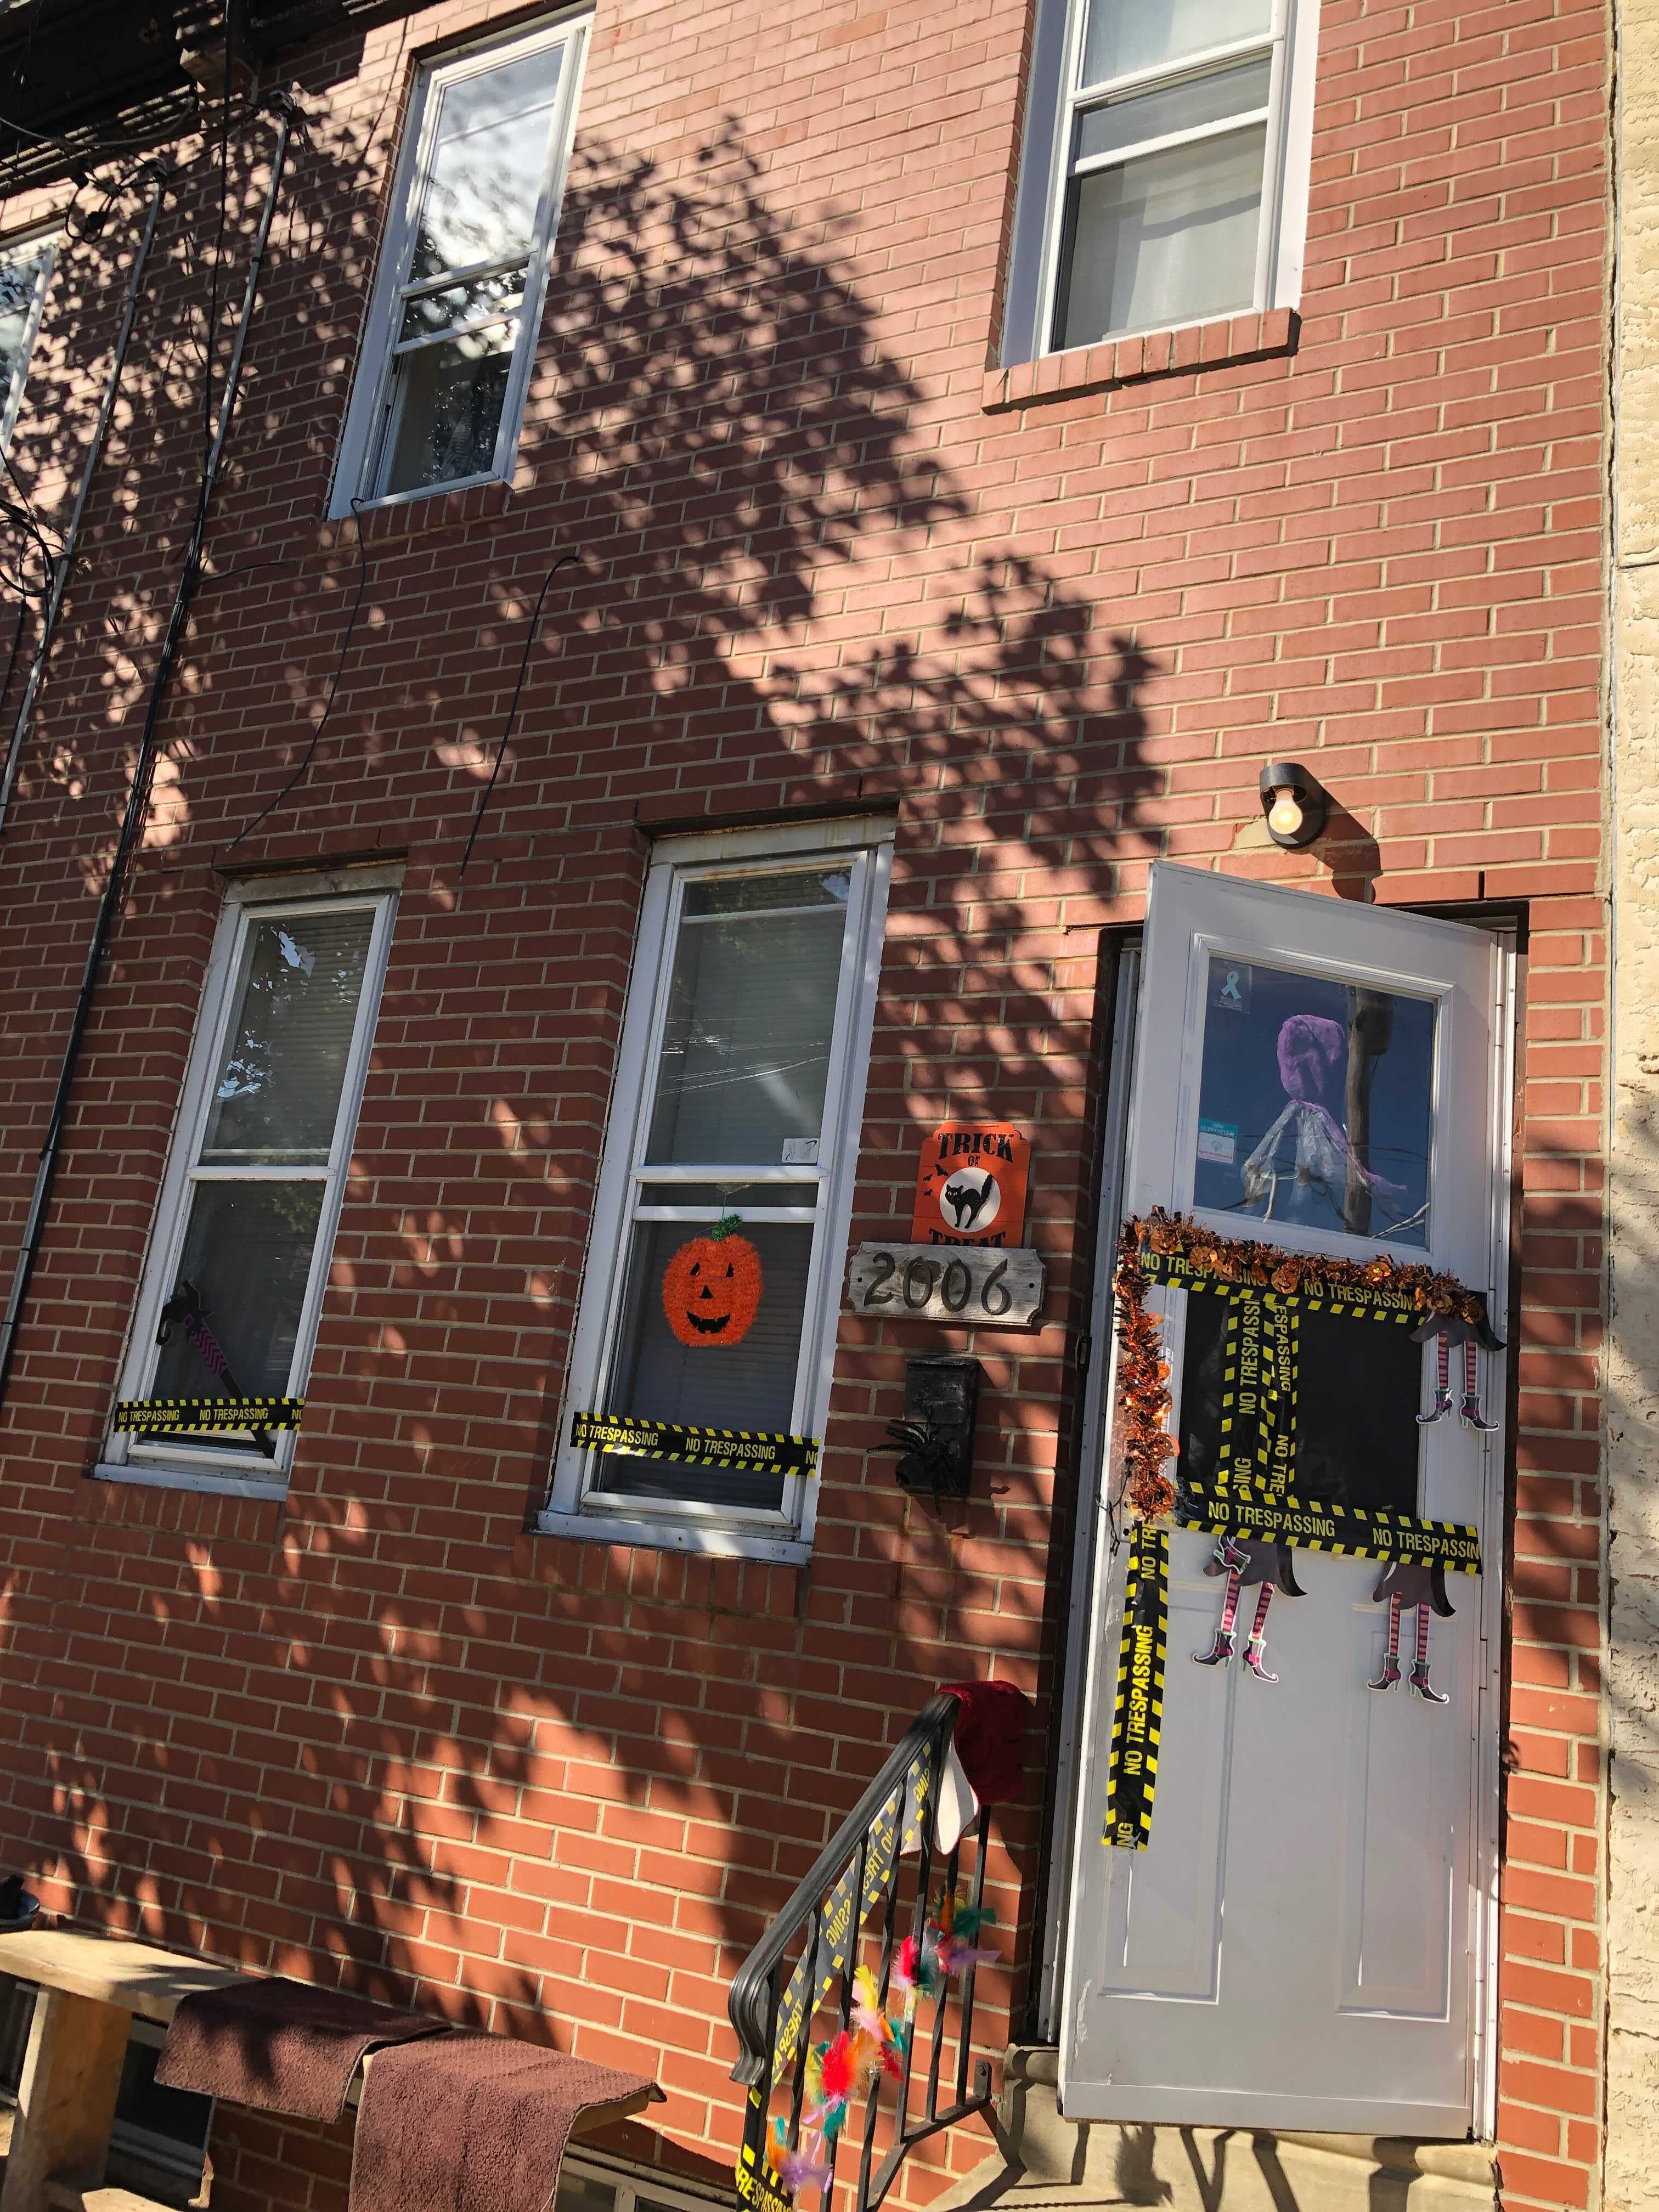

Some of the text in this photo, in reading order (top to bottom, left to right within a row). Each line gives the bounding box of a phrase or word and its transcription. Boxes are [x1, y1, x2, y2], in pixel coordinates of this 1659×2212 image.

[938, 1133, 1014, 1163] TRICK
[864, 1252, 1012, 1316] 2006
[1141, 1252, 1160, 1271] NO
[1304, 1279, 1324, 1297] NO
[1328, 1283, 1413, 1311] TRESPASSIN
[118, 1412, 127, 1423] NO
[129, 1409, 180, 1422] TRESPASSING
[199, 1409, 211, 1421] NO
[213, 1408, 268, 1420] TRESPASSING
[1238, 1392, 1257, 1415] NO
[576, 1424, 586, 1437] NO
[589, 1425, 658, 1446] TRESPASSING
[685, 1437, 701, 1452] NO
[704, 1440, 776, 1460] TRESPASSING
[1274, 1434, 1289, 1457] NO
[1269, 1463, 1287, 1497] TRE
[1208, 1500, 1229, 1521] NO
[1235, 1505, 1335, 1537] TRESPASSING
[1373, 1527, 1392, 1547] NO
[1141, 1556, 1156, 1580] NO
[1126, 1624, 1153, 1743] TRESPASSING
[1124, 1750, 1143, 1776] NO
